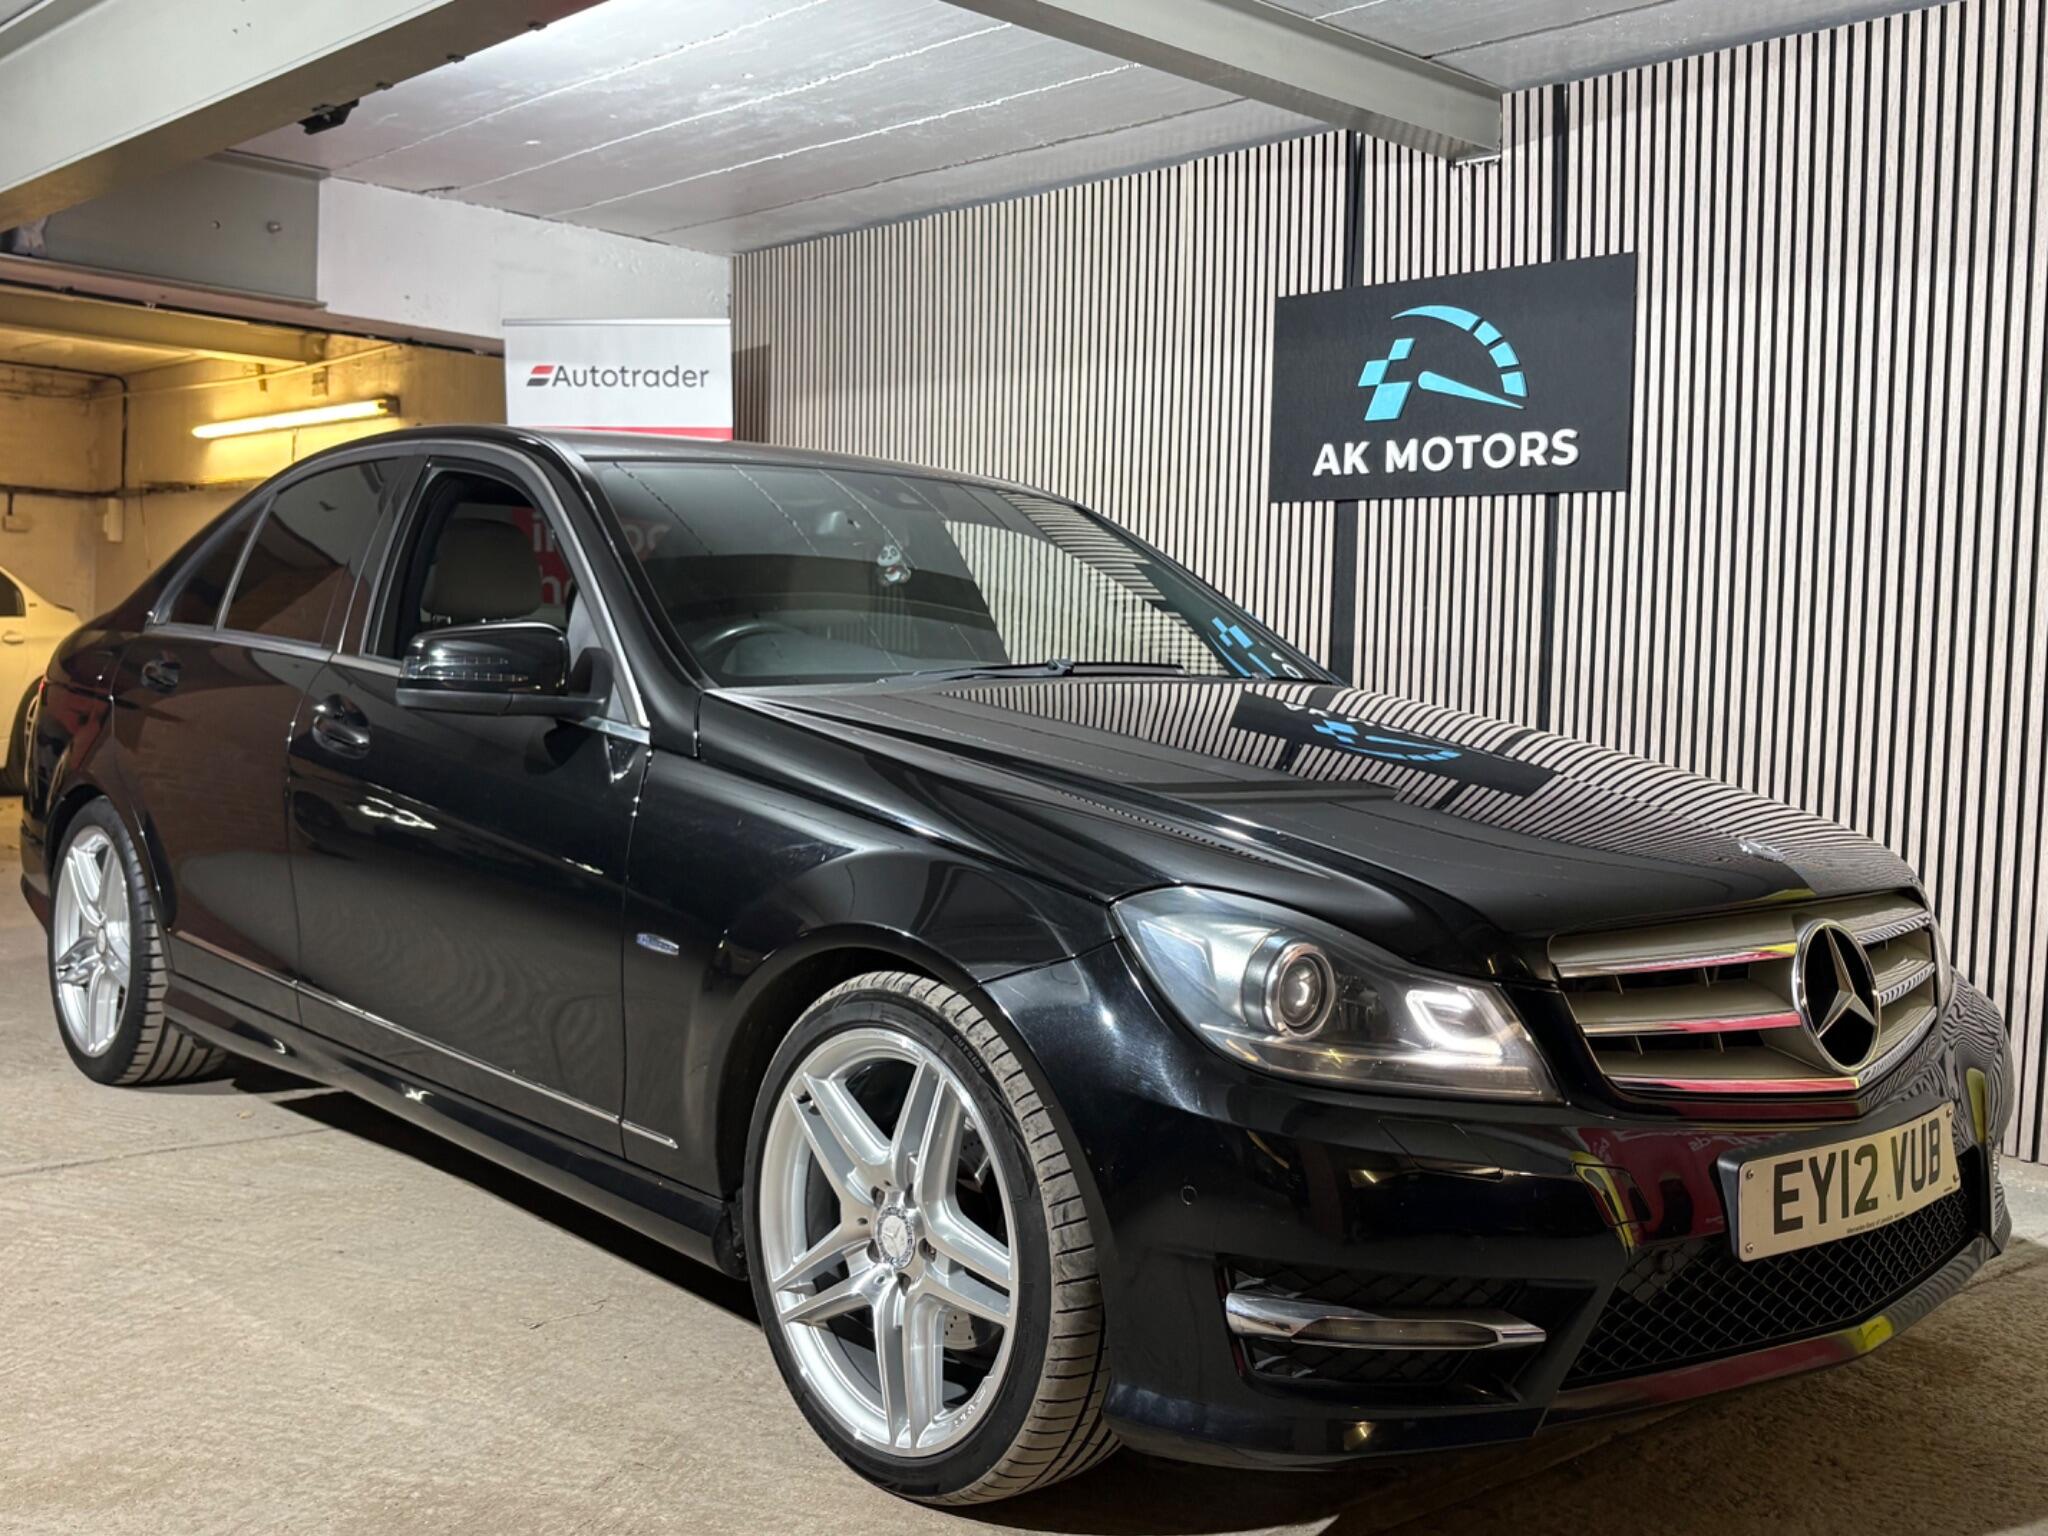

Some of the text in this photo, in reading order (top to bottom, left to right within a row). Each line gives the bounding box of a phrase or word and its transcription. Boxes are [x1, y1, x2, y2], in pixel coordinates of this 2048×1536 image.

[552, 365, 710, 388] Autotrader
[1311, 428, 1580, 477] AK MOTORS
[1773, 1117, 1942, 1236] EY12 VUB
